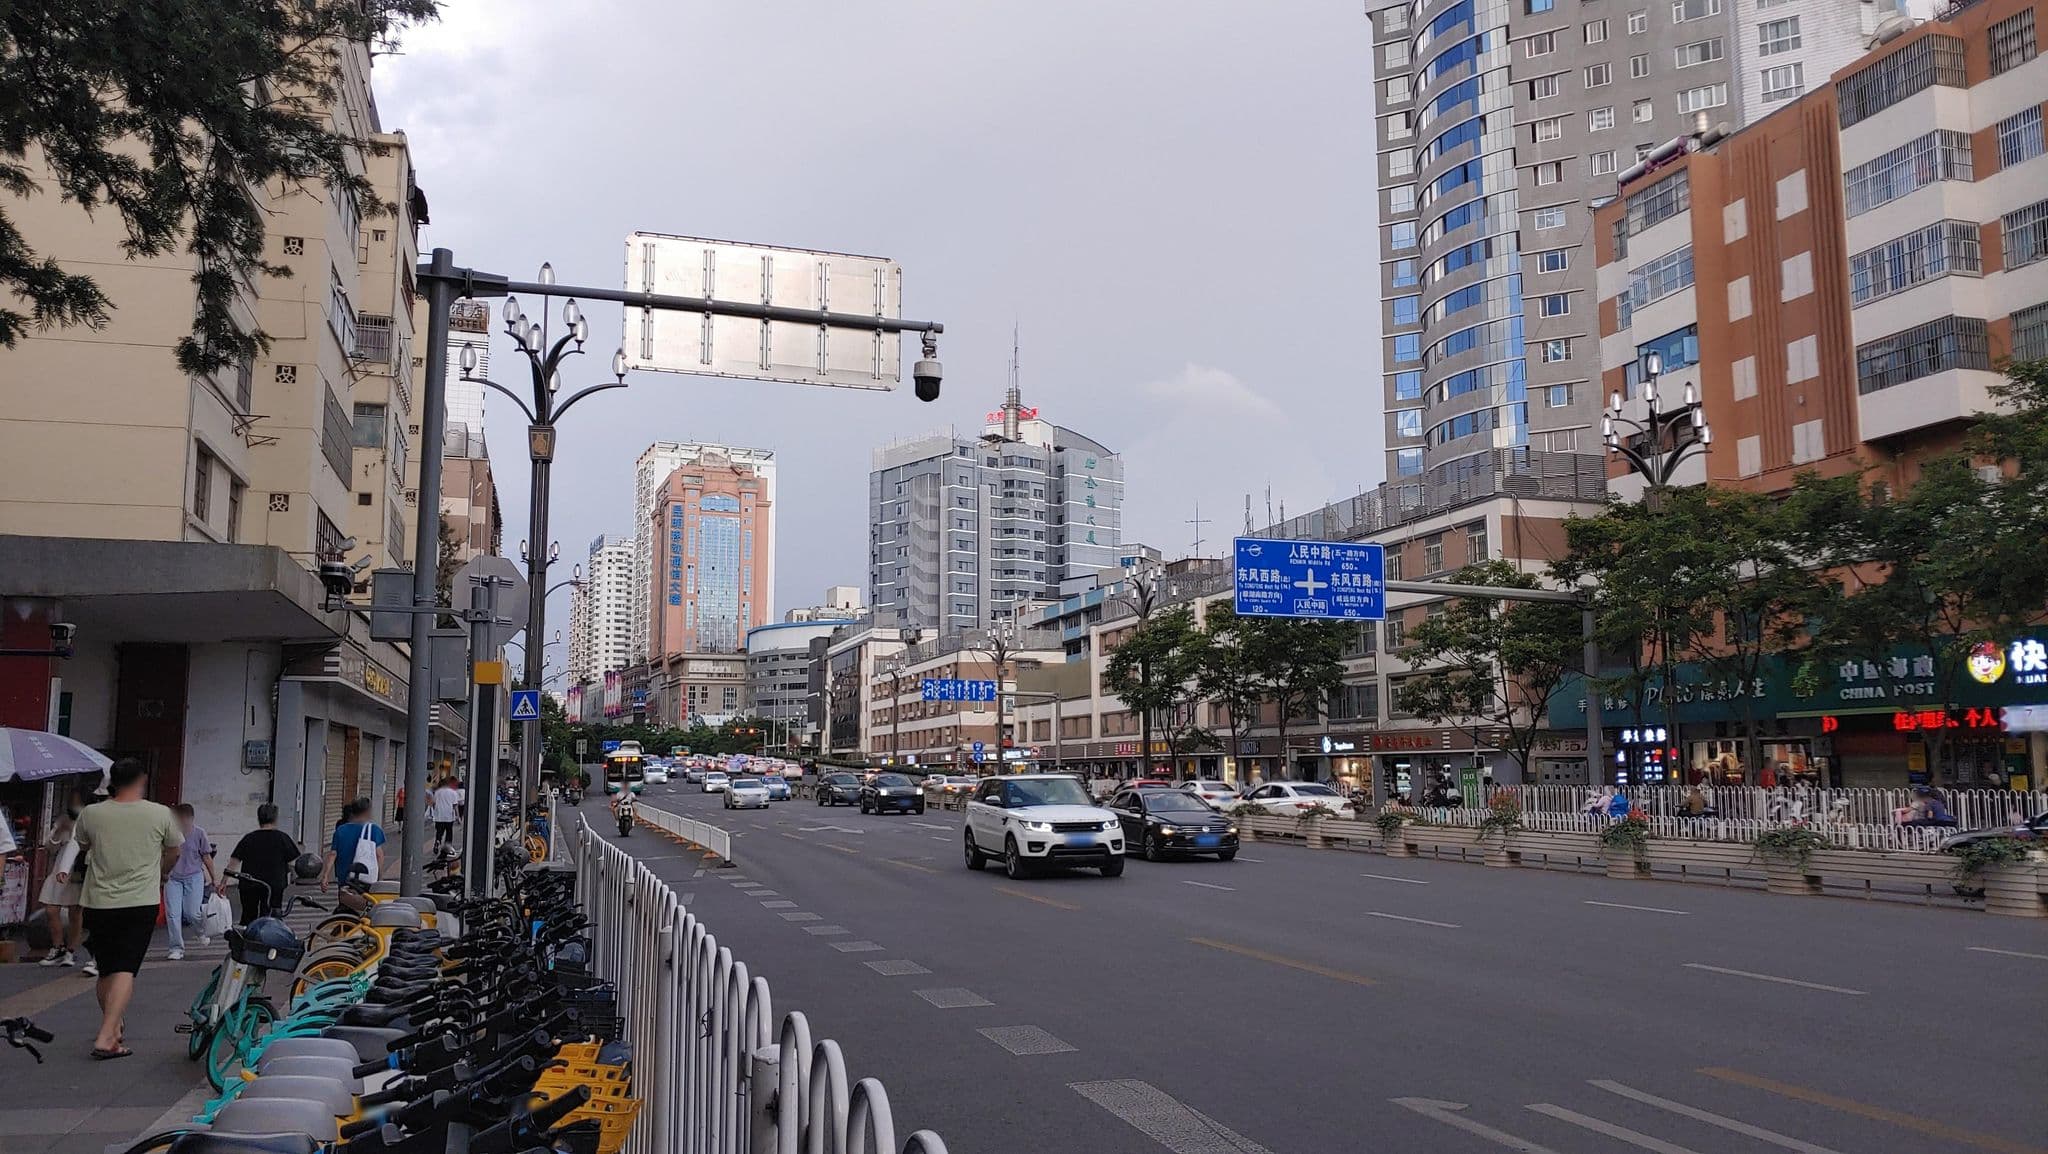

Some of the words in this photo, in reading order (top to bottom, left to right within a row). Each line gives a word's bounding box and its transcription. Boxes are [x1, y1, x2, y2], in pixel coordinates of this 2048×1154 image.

[1288, 543, 1331, 560] 人民中路
[1296, 600, 1326, 610] 人民中路
[2009, 638, 2048, 672] 快
[1838, 686, 1887, 701] CHINA
[1892, 682, 1936, 697] POST
